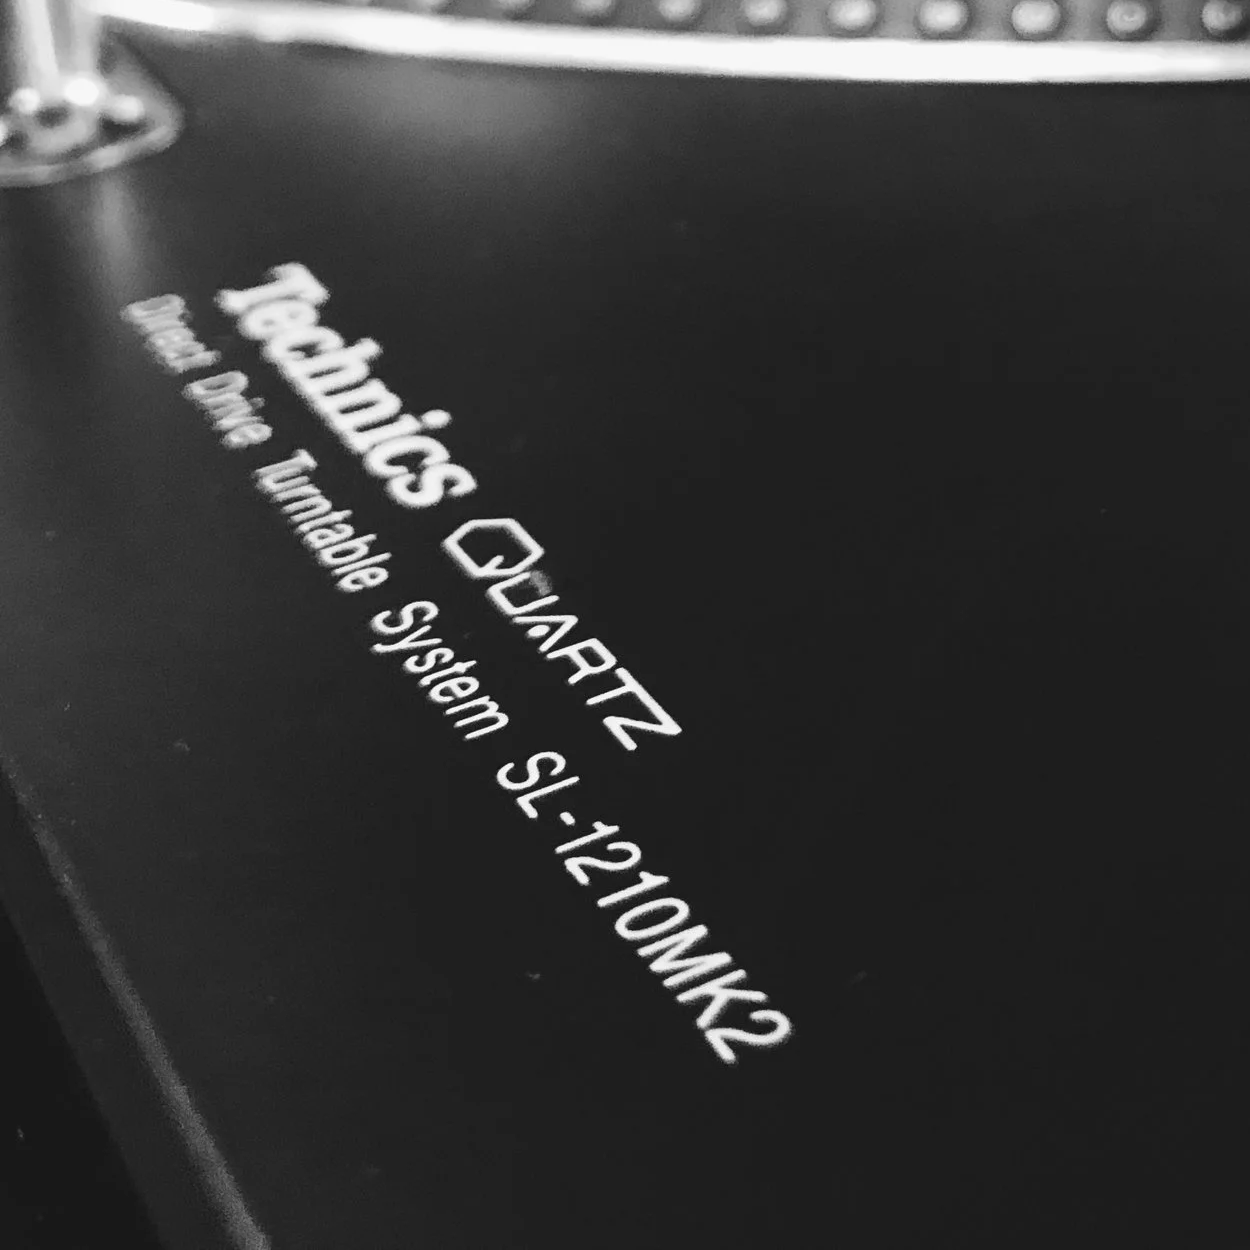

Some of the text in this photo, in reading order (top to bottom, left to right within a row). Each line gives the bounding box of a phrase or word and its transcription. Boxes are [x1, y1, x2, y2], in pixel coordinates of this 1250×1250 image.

[122, 293, 794, 1064] Direct Drive Turntable System SL-1210MK2
[215, 262, 683, 751] Technics QUARTZ
